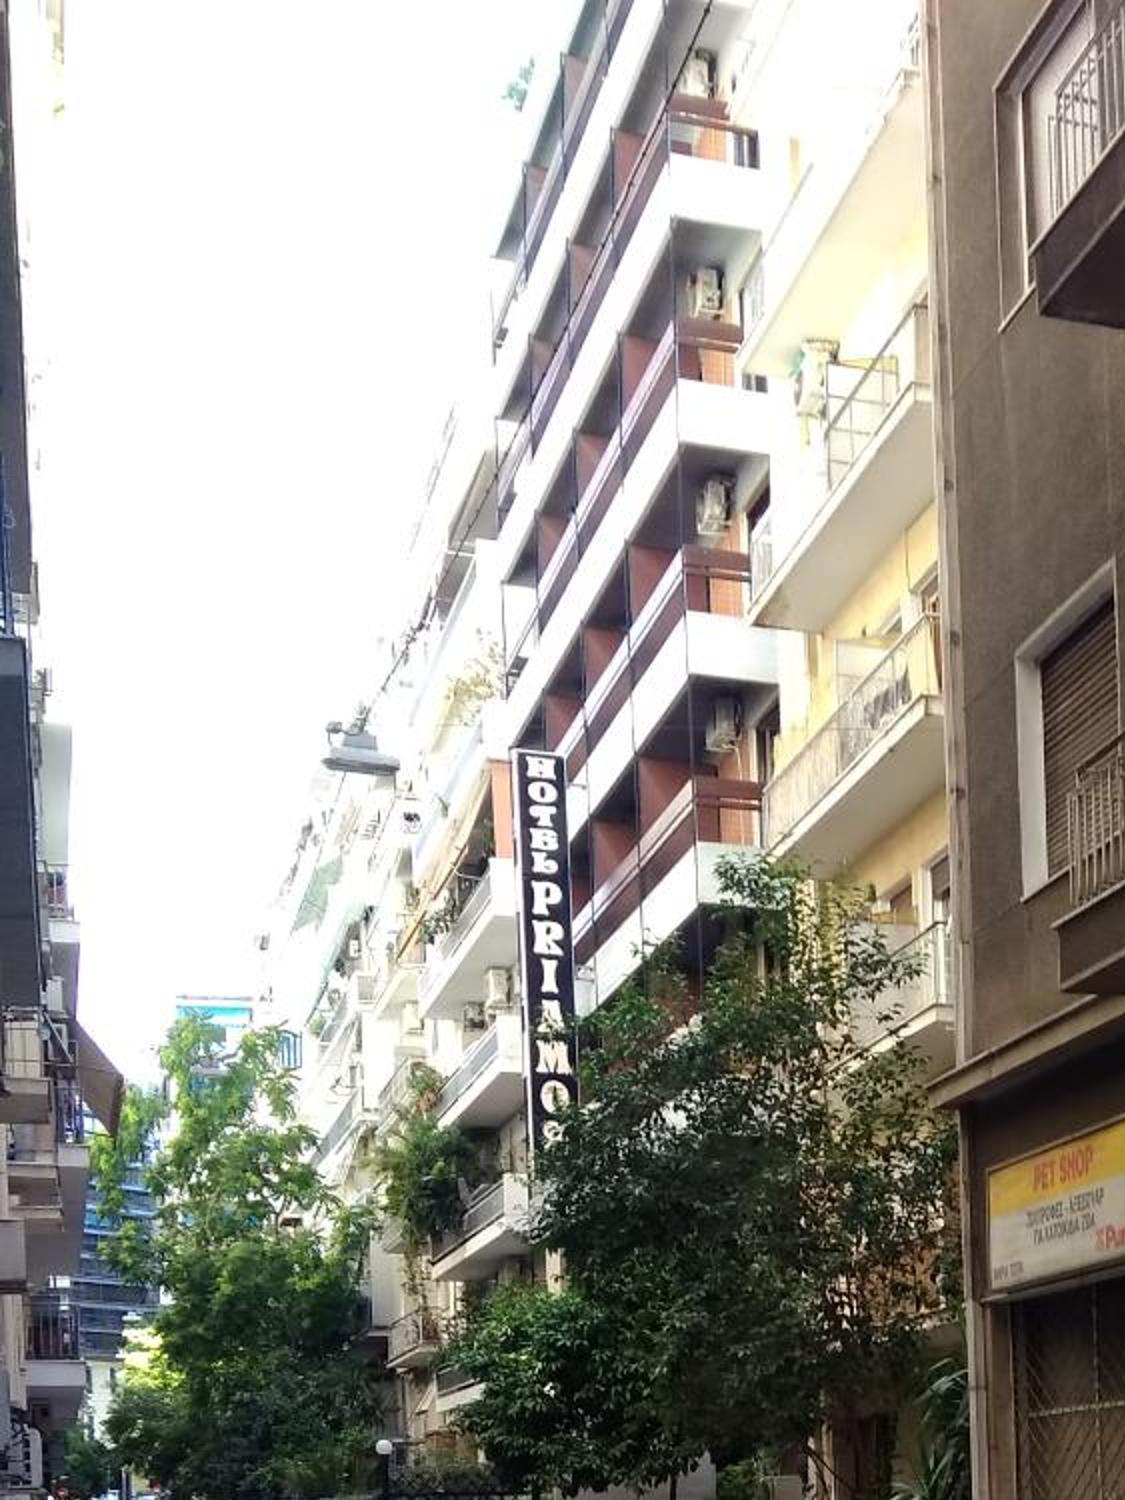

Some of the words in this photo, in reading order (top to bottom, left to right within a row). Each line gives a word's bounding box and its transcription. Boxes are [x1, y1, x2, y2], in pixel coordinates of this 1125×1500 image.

[525, 755, 559, 874] HOTEL
[1034, 1161, 1056, 1193] PET
[1060, 1145, 1094, 1184] SHOP
